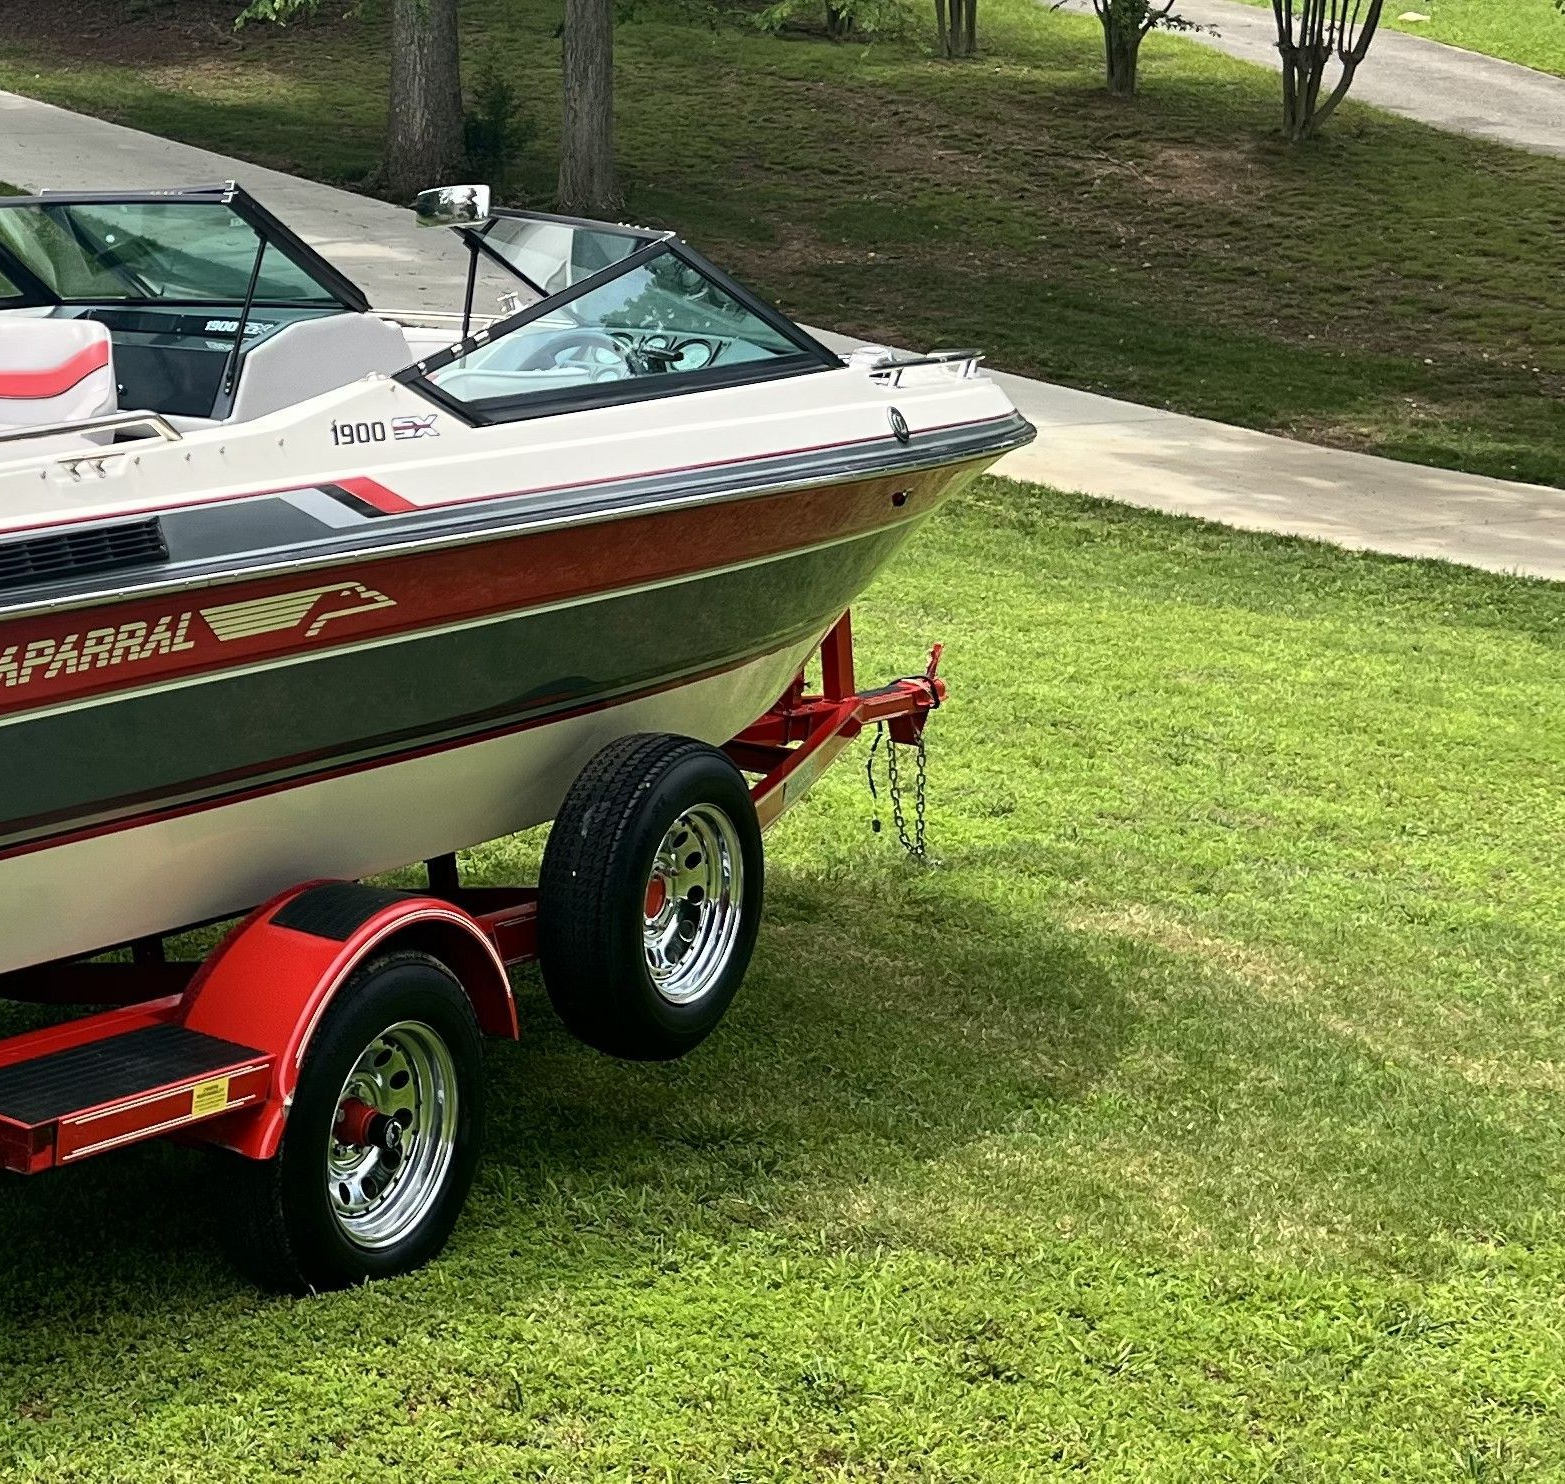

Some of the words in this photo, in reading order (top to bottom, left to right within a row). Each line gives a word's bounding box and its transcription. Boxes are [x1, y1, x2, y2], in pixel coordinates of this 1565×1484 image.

[205, 320, 240, 332] 1900
[331, 420, 386, 445] 1900
[391, 414, 440, 440] SX
